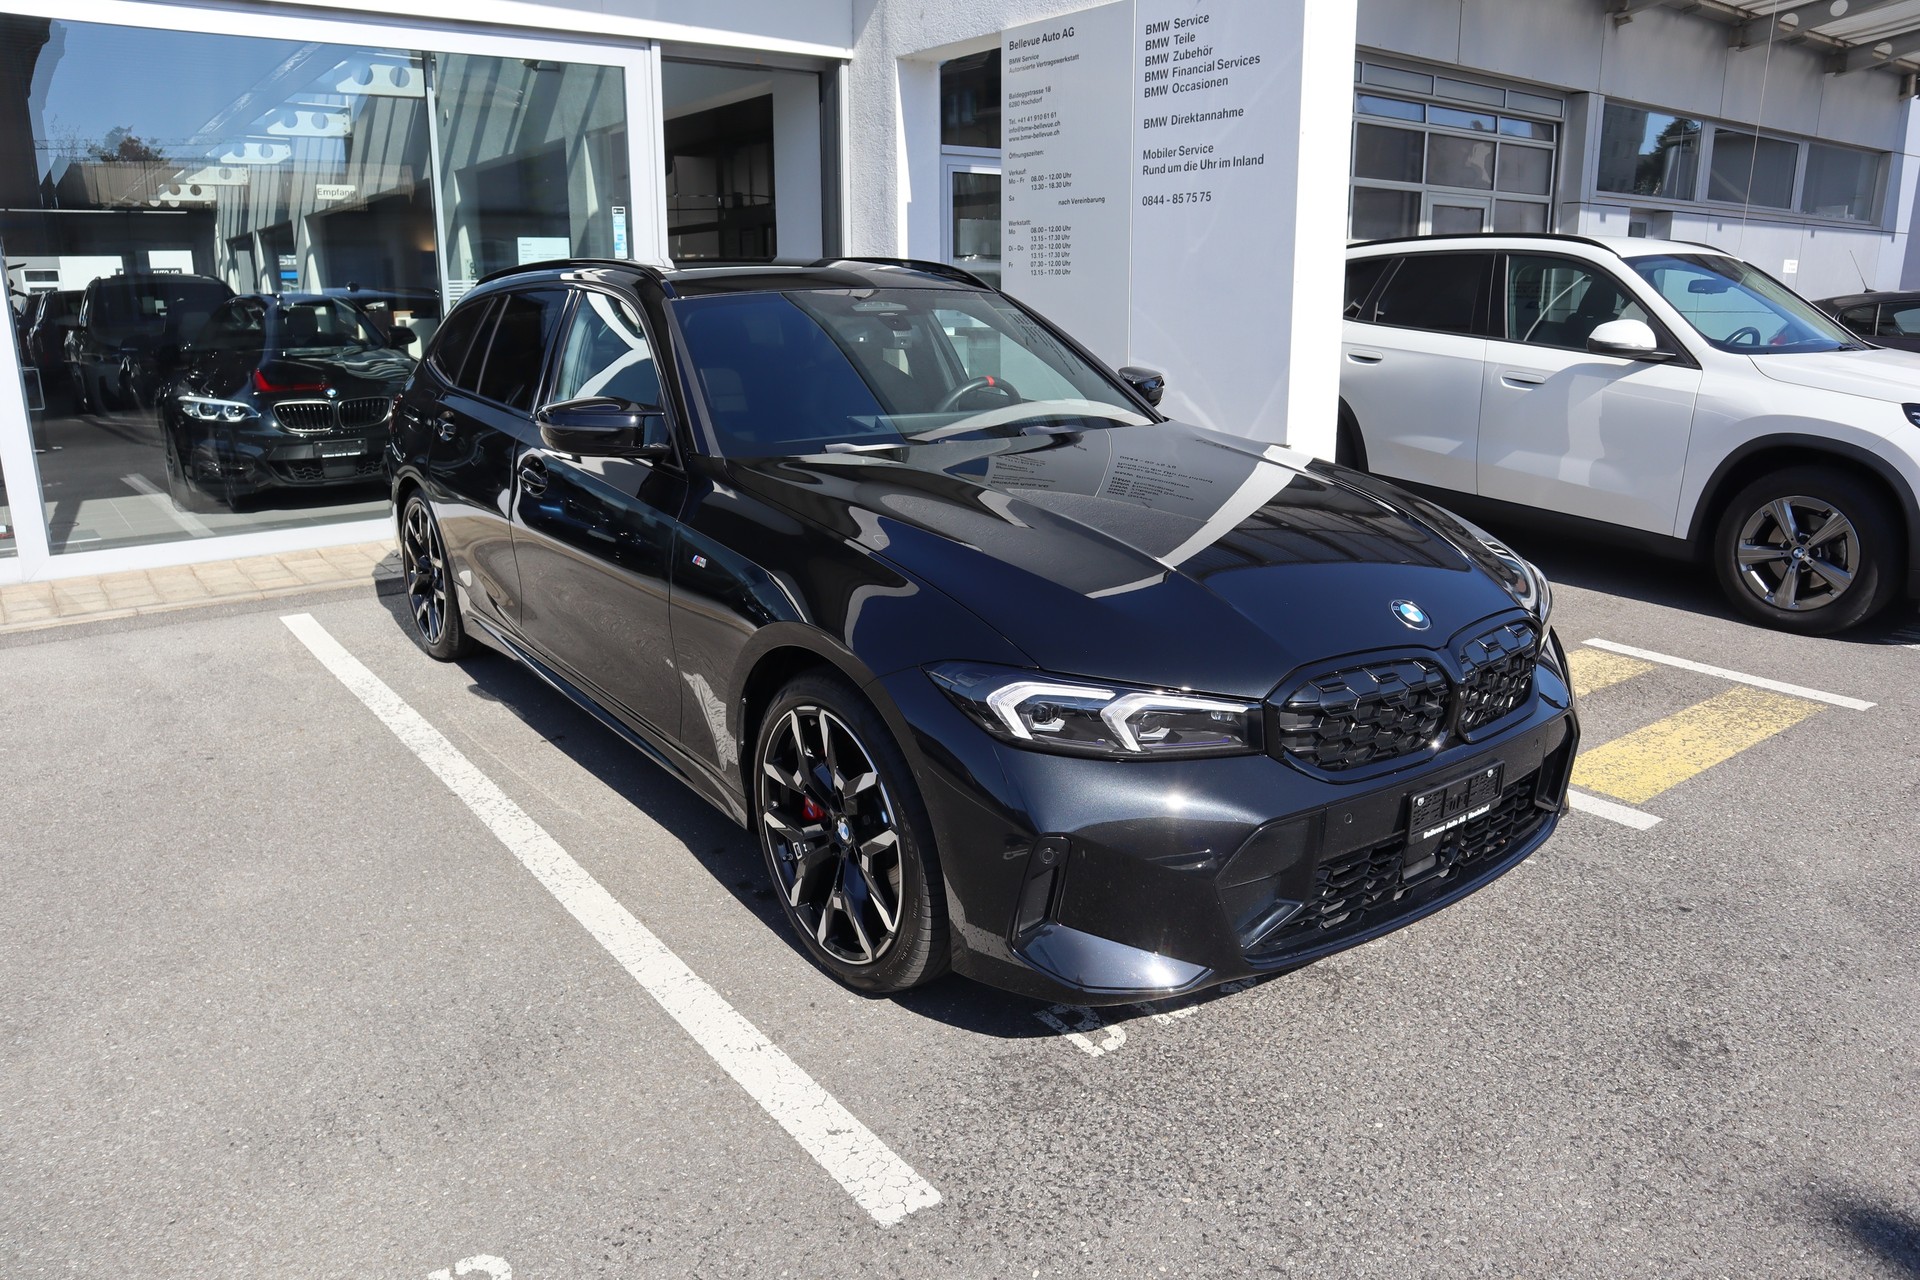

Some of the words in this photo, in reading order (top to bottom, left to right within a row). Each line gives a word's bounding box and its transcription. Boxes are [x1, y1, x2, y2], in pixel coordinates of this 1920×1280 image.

[1146, 20, 1170, 35] BMW
[1173, 14, 1210, 29] Service
[1009, 36, 1040, 51] Bellevue
[1042, 31, 1061, 43] Auto
[1062, 27, 1075, 38] AG
[1145, 36, 1170, 51] BMW
[1173, 32, 1196, 46] Teile
[1009, 57, 1021, 65] BMW
[1022, 54, 1039, 63] Service
[1009, 63, 1036, 74] Autorisierte
[1036, 54, 1080, 68] Vertragswerkstatt
[1145, 52, 1169, 67] BMW
[1173, 45, 1213, 62] Zubehör
[1145, 69, 1169, 83] BMW
[1172, 61, 1215, 78] Financial
[1217, 54, 1261, 71] Services
[1009, 87, 1044, 100] Baldeggstrasse
[1144, 84, 1168, 98] BMW
[1172, 76, 1229, 94] Occasionen
[1009, 100, 1020, 108] 6280
[1021, 97, 1043, 106] Hochdorf
[1051, 111, 1057, 119] 61
[1144, 116, 1168, 129] BMW
[1171, 107, 1244, 126] Direktannahme
[1009, 121, 1061, 134] info@bmw-bellevue.ch
[1009, 130, 1060, 142] www.bmw-bellevue.ch
[1143, 146, 1177, 160] Mobiler
[1179, 143, 1214, 157] Service
[1143, 162, 1166, 176] Rund
[1168, 164, 1182, 173] um
[1184, 160, 1198, 172] die
[1200, 157, 1217, 170] Uhr
[1219, 157, 1231, 168] im
[1233, 154, 1264, 168] Inland
[1058, 198, 1070, 206] nach
[1071, 196, 1105, 205] Vereinbarung
[1142, 194, 1164, 206] 0844
[1172, 193, 1184, 204] 85
[1186, 192, 1198, 203] 75
[1200, 191, 1212, 202] 75
